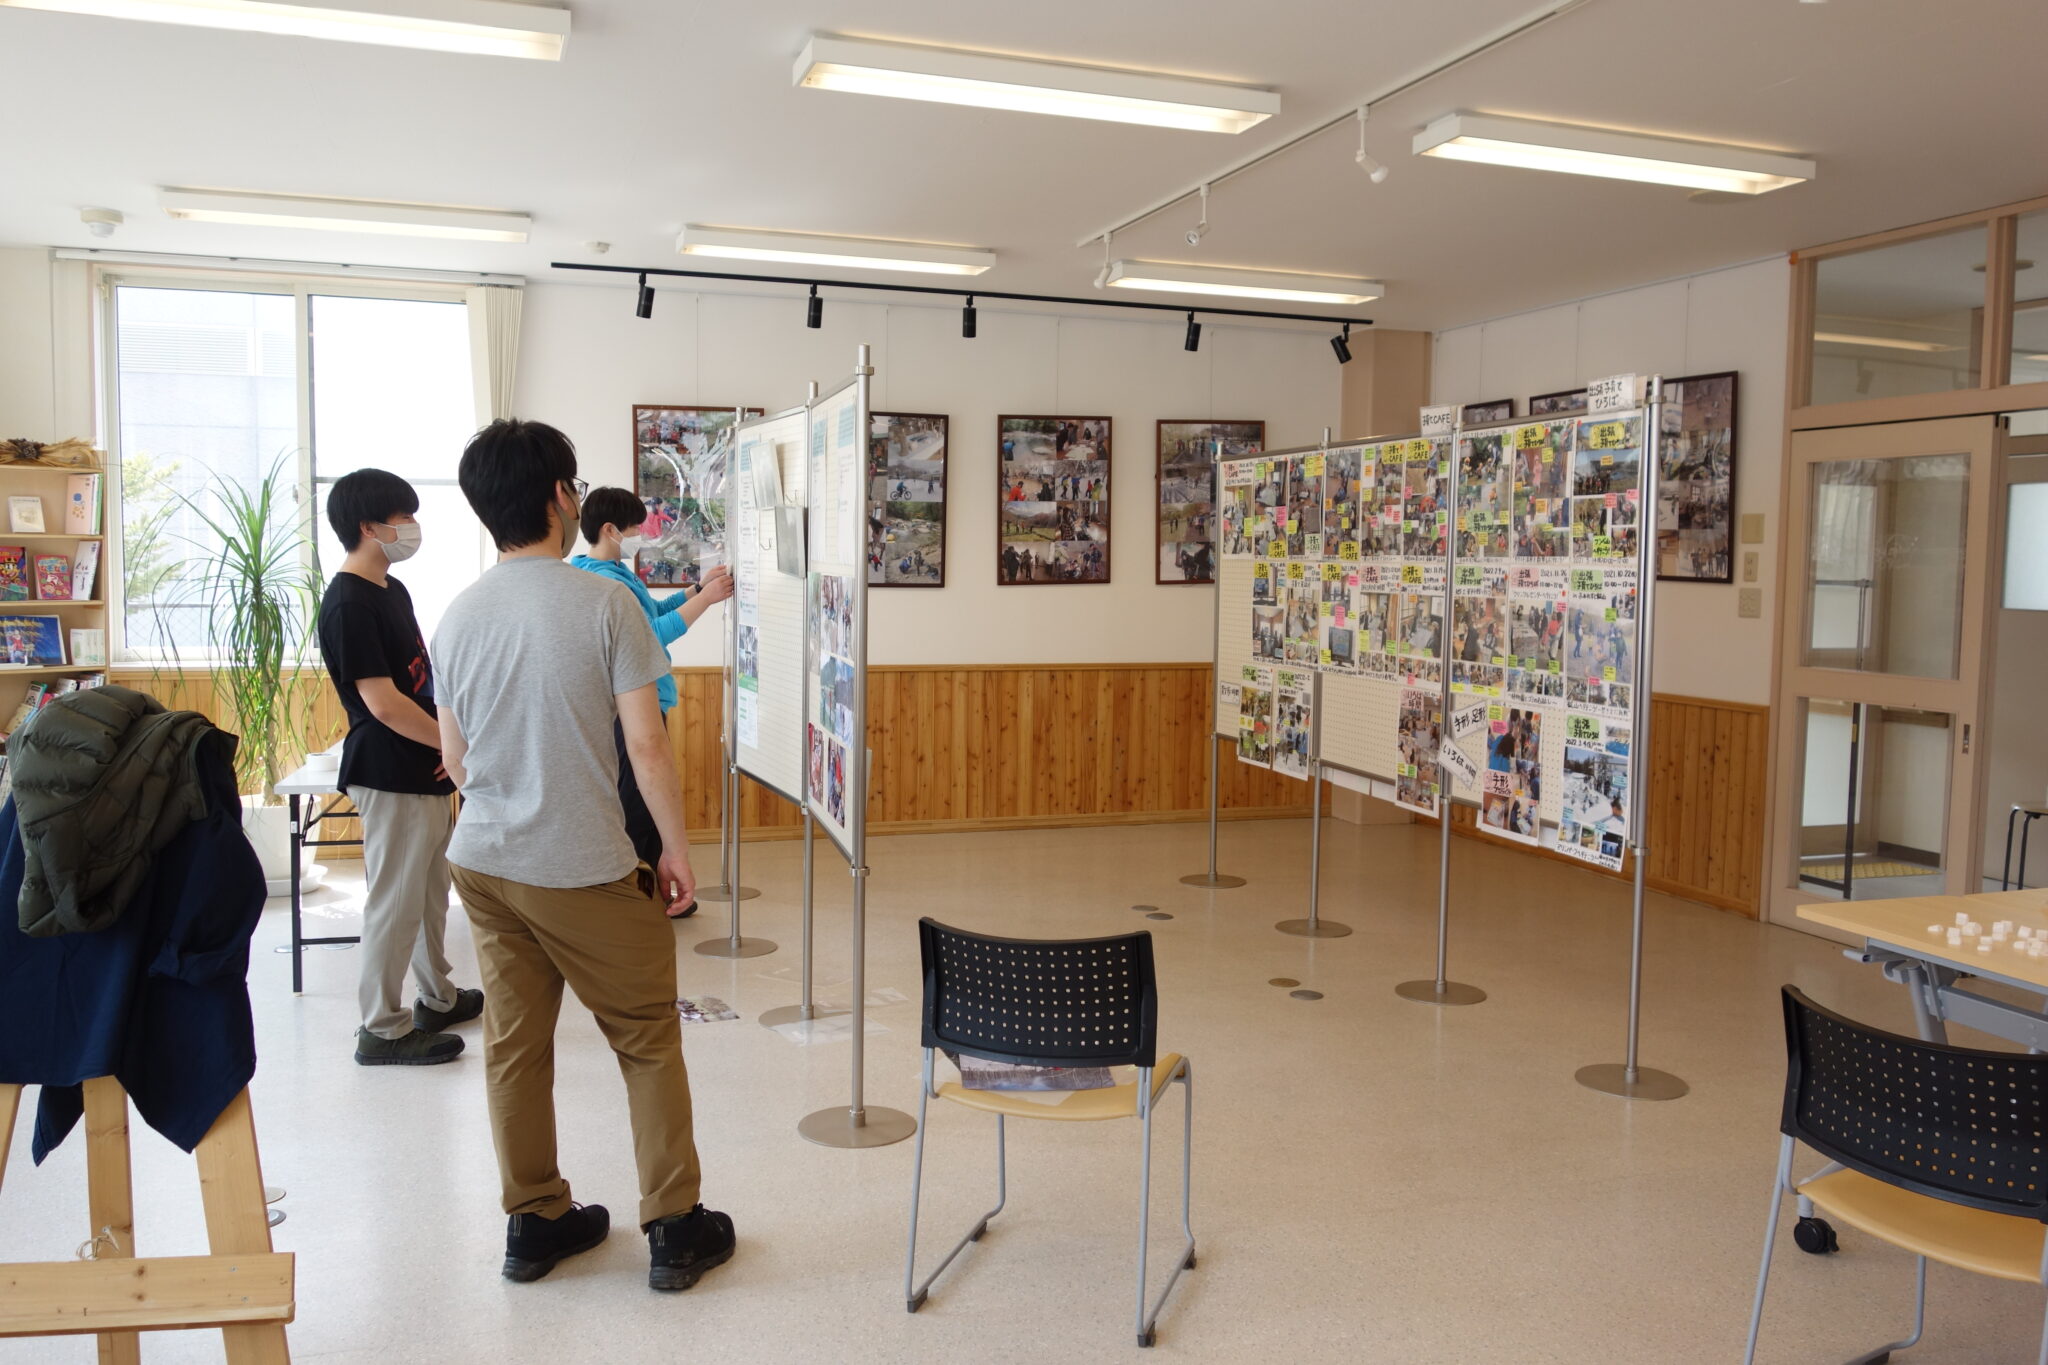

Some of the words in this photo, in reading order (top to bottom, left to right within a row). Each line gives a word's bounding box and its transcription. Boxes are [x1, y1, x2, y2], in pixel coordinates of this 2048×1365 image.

[1589, 380, 1623, 397] 出張子育て
[1595, 394, 1620, 408] ひろば
[1523, 428, 1537, 438] 出張
[1600, 426, 1616, 437] 出張
[1389, 454, 1403, 462] CAFE
[1414, 450, 1429, 459] CAFE
[1345, 552, 1358, 560] CAFE
[1327, 572, 1341, 580] CAFE
[1461, 568, 1475, 577] 出張
[1519, 569, 1531, 578] 出張
[1578, 570, 1593, 580] 出張
[1573, 718, 1590, 729] 出張
[1443, 744, 1465, 767] いろは
[1493, 772, 1509, 788] 手形
